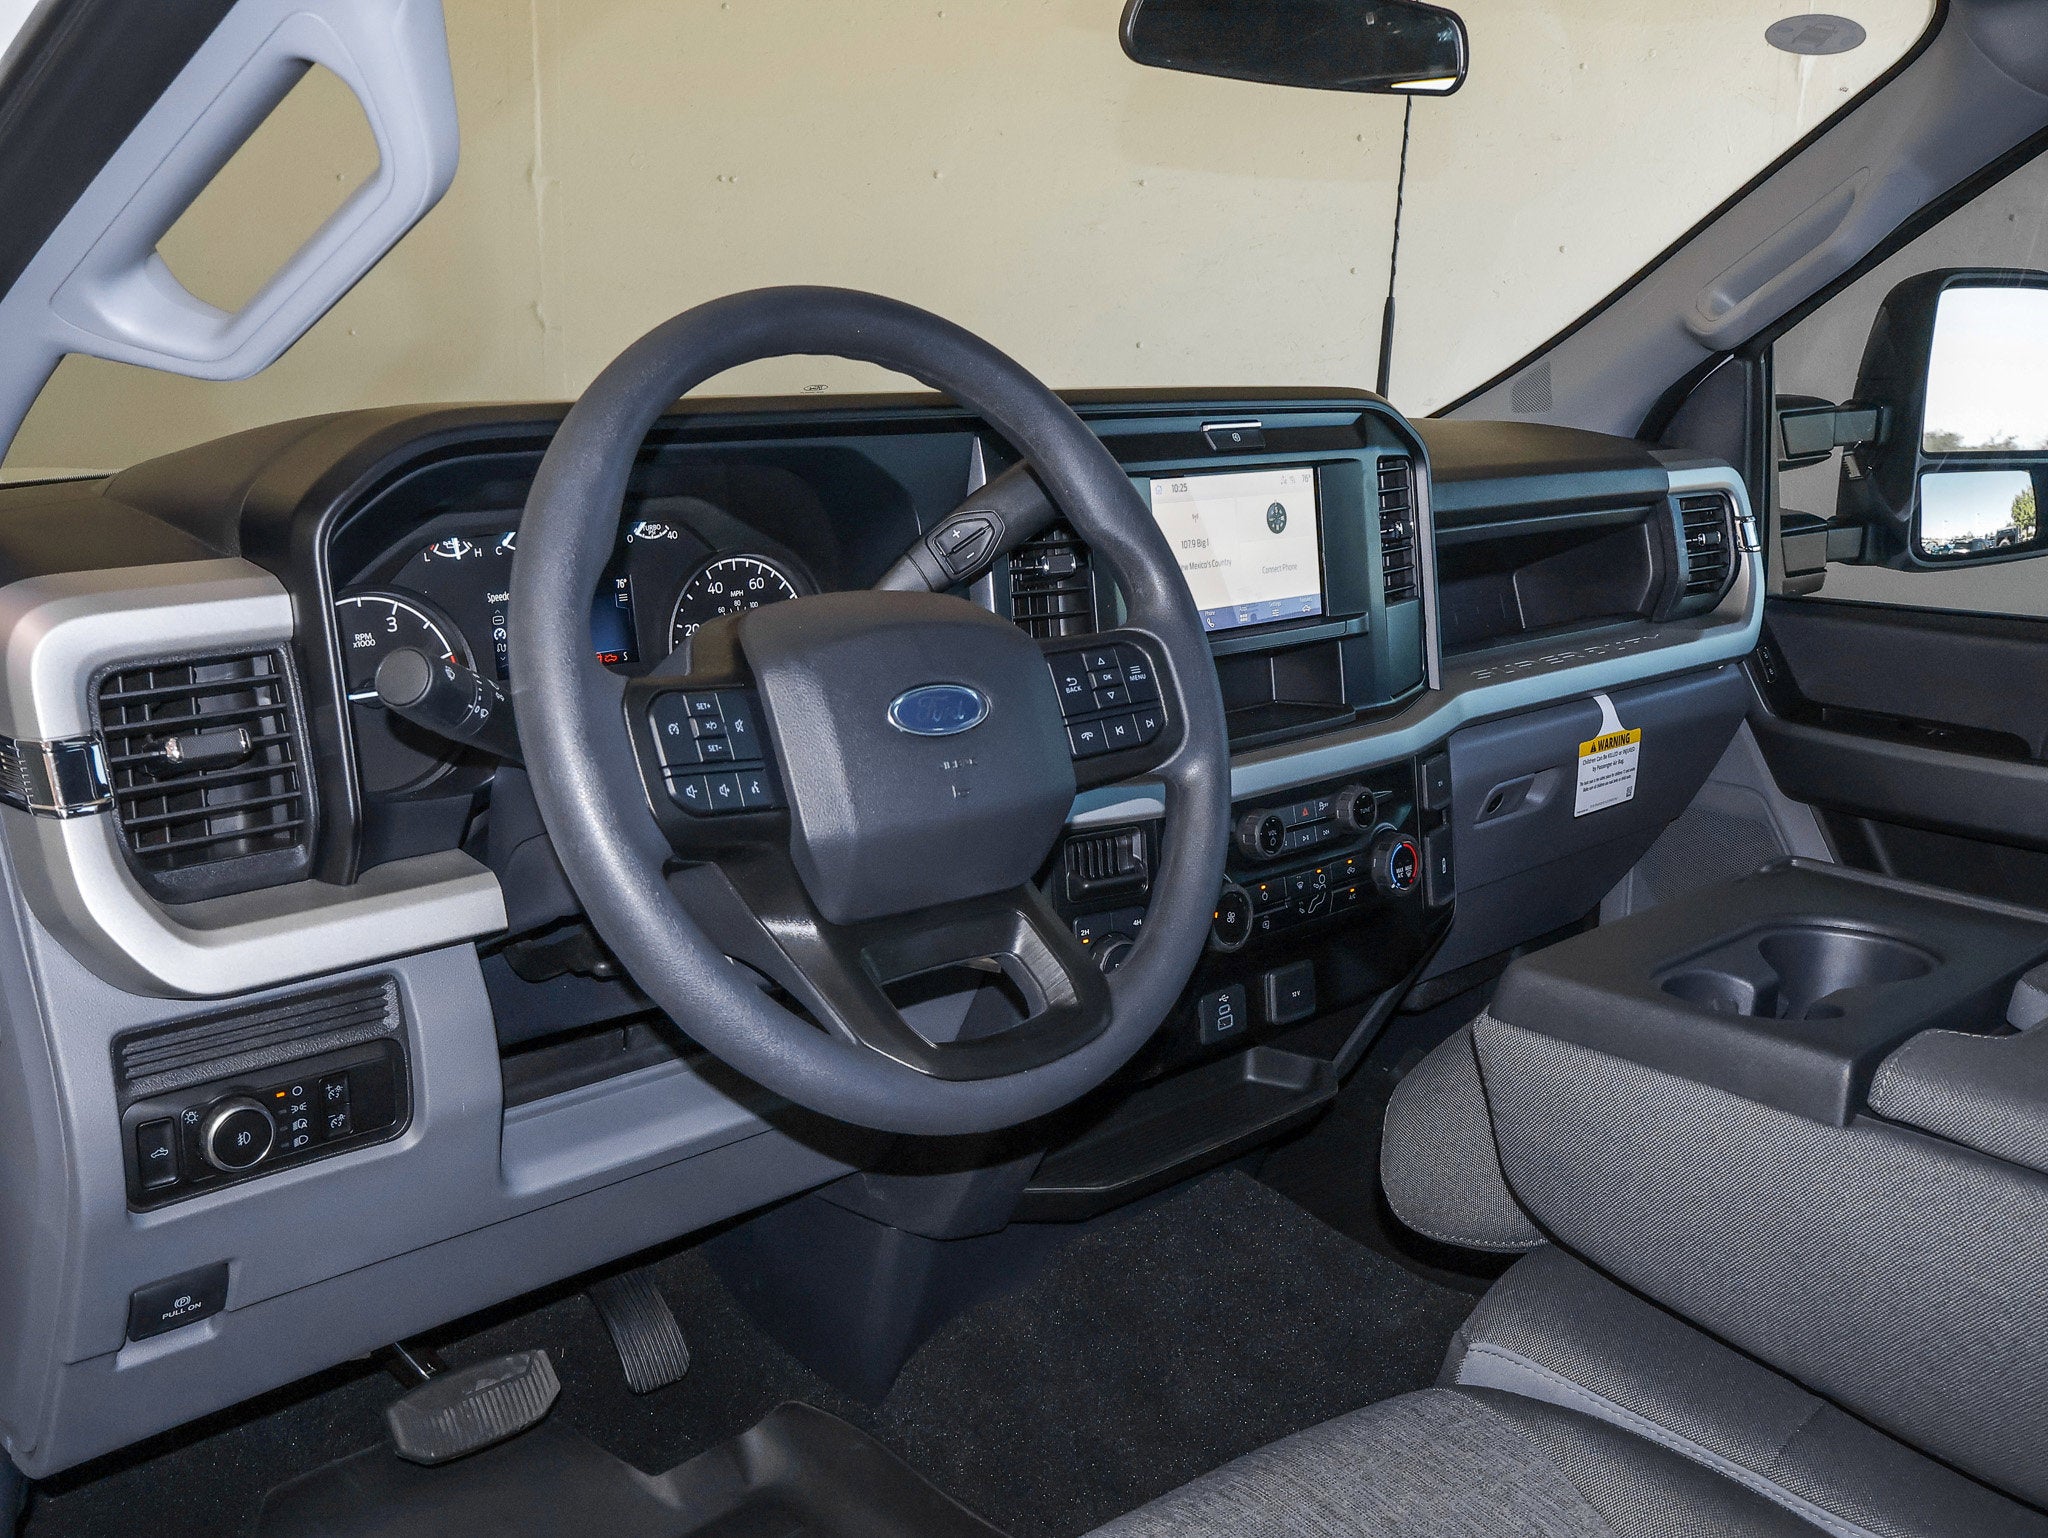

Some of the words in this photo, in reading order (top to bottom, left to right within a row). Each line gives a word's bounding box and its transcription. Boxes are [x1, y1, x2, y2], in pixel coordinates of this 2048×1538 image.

[1171, 482, 1188, 493] 10:25
[626, 534, 634, 544] 0
[667, 530, 678, 540] 40
[474, 548, 482, 558] H
[495, 546, 503, 556] C
[424, 552, 431, 562] L
[1189, 560, 1211, 570] Mexico's
[1212, 558, 1232, 568] Country
[1262, 564, 1282, 574] Connect
[1282, 562, 1298, 572] Phone
[707, 581, 724, 595] 40
[748, 577, 765, 590] 60
[730, 590, 744, 598] MPH
[717, 606, 726, 614] 60
[386, 616, 398, 633] 3
[354, 632, 373, 642] RPM
[352, 640, 376, 649] x1000
[1129, 674, 1146, 682] MENU
[1065, 686, 1082, 694] BACK
[696, 702, 711, 710] SET+
[1597, 732, 1631, 753] WARNING
[1080, 928, 1090, 936] 2H
[162, 1308, 186, 1320] PULL
[187, 1301, 202, 1311] ON
